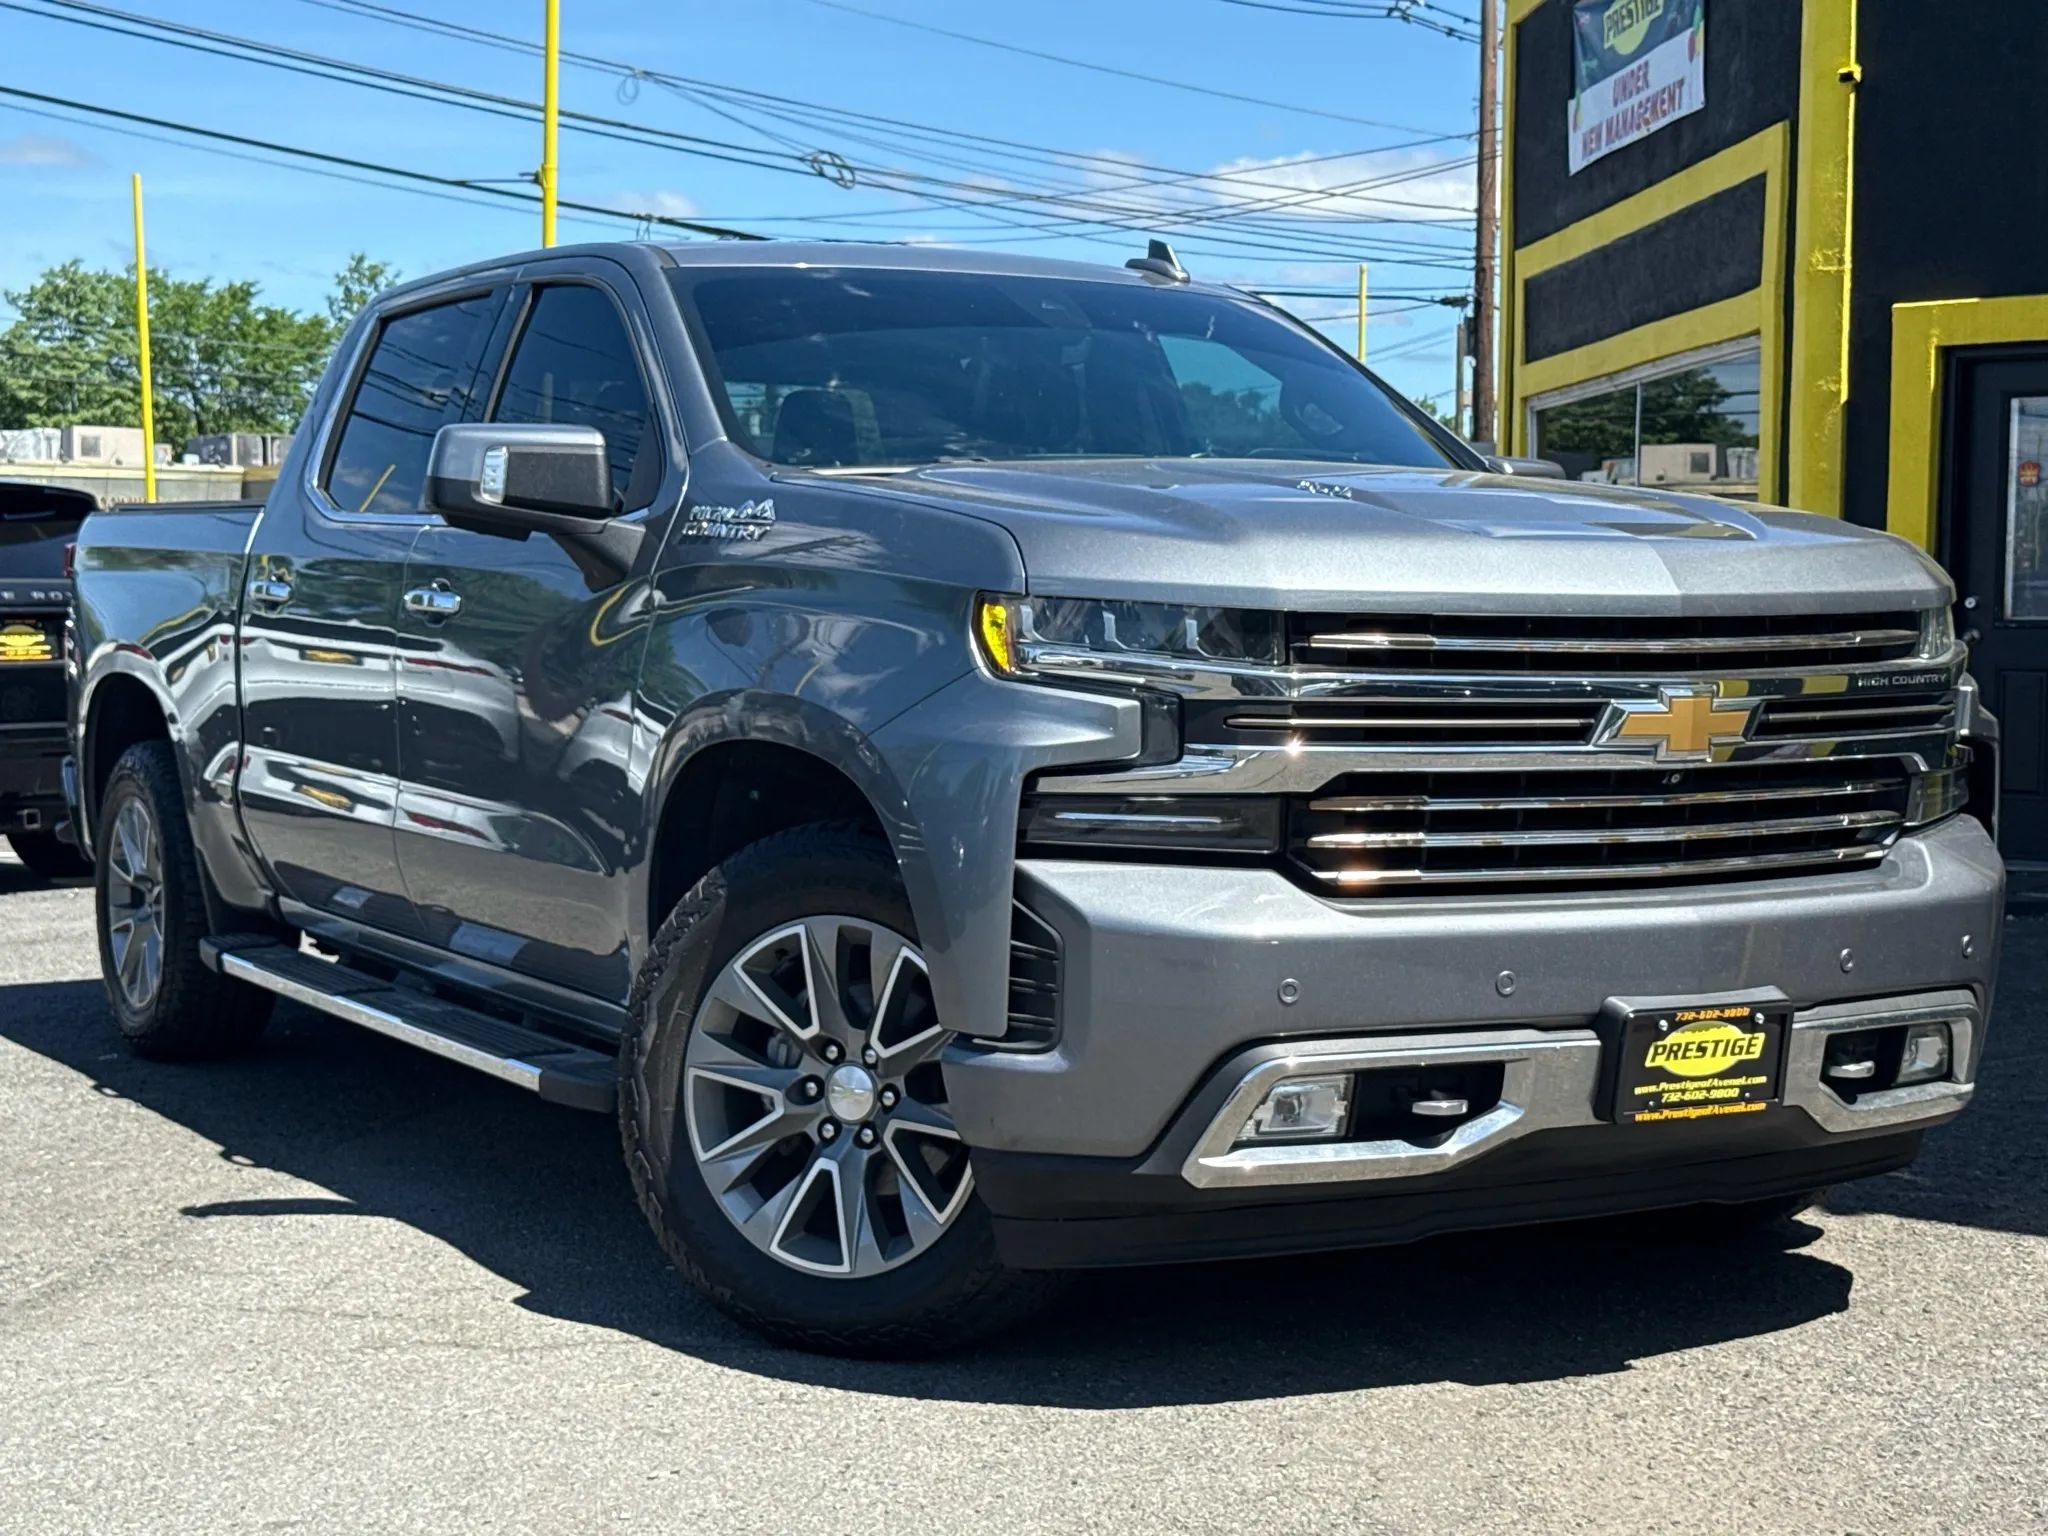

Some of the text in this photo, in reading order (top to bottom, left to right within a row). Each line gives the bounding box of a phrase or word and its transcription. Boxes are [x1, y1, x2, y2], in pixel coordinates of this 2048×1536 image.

[1613, 60, 1649, 107] UNDER
[1582, 76, 1685, 160] NEW MANAGEMENT
[1858, 673, 1947, 687] HIGH COUNTRY
[1650, 1035, 1760, 1063] PRESTIGE
